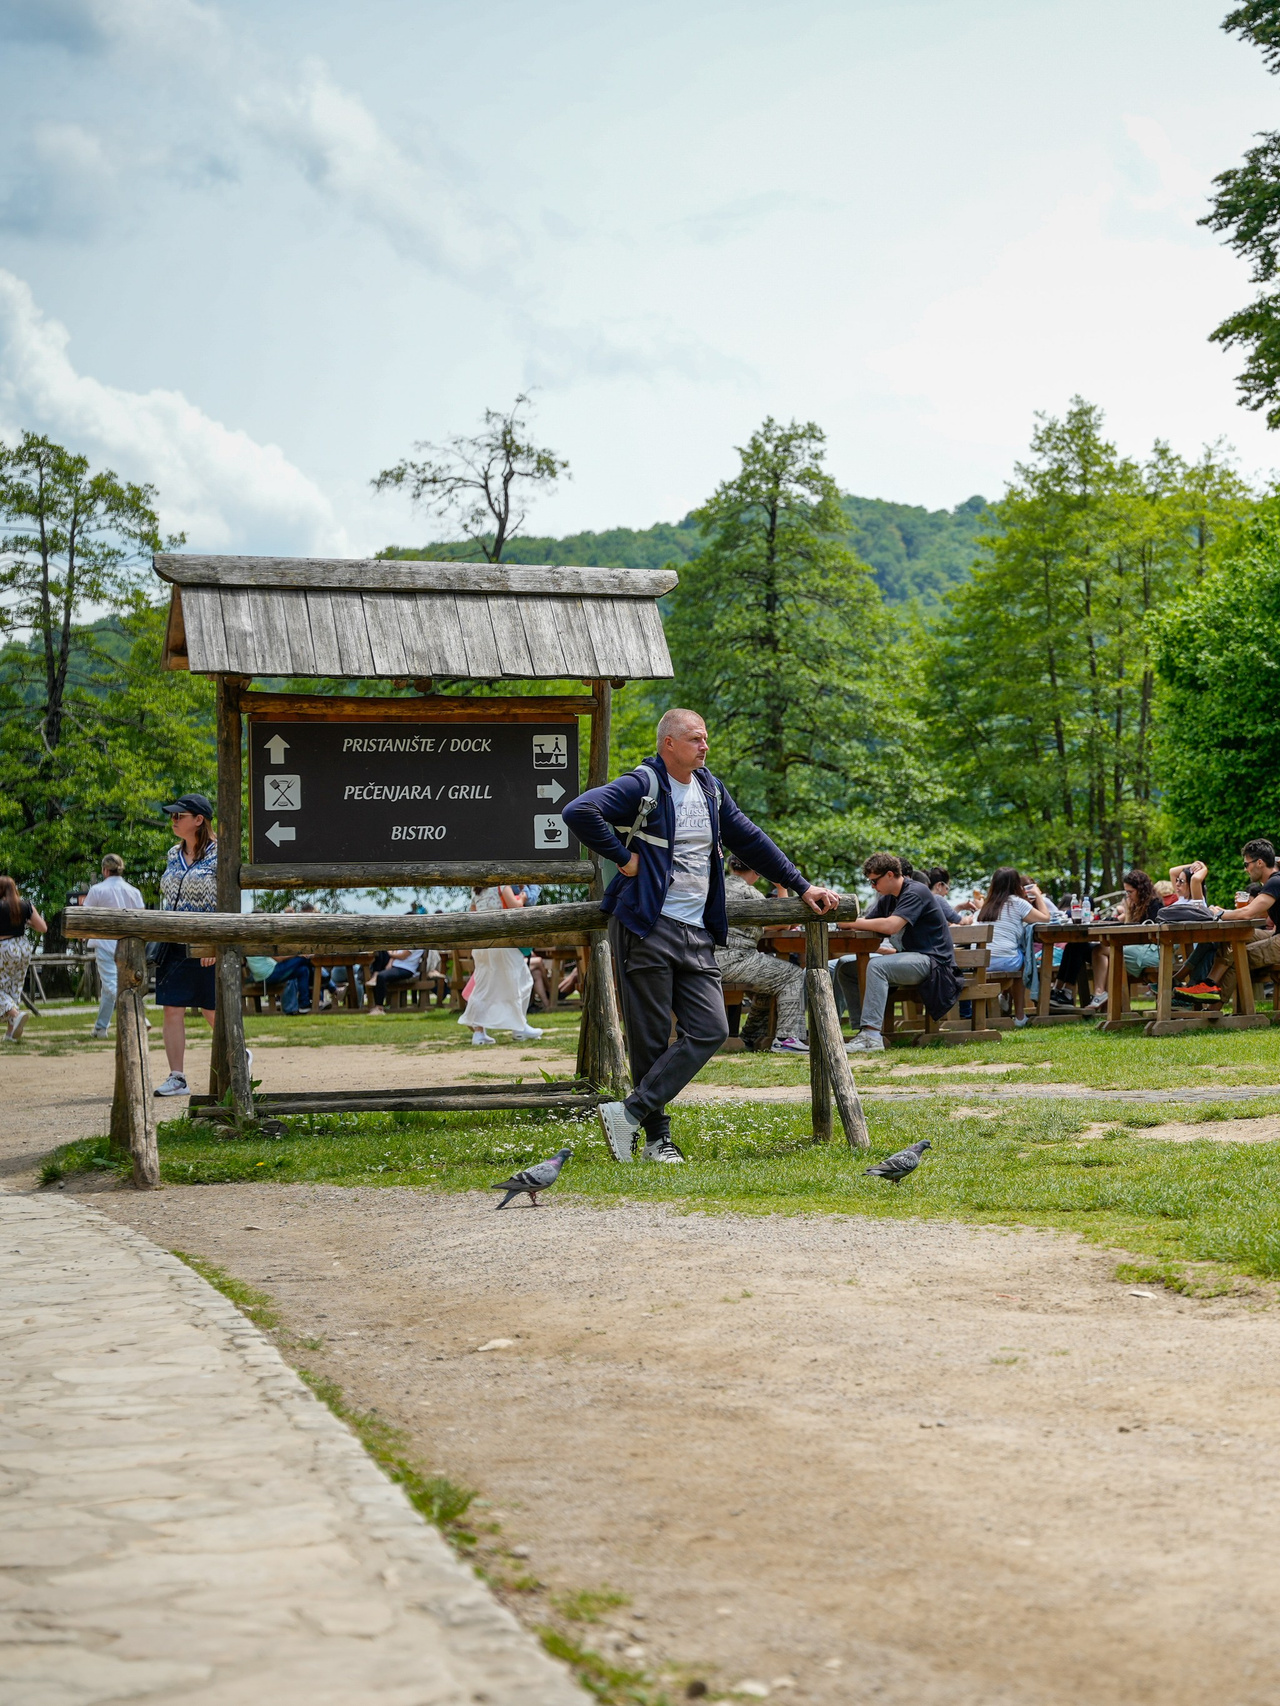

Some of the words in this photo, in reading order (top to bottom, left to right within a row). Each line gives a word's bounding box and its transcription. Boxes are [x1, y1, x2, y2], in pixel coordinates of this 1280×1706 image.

[342, 735, 435, 752] PRISTANIŠTE
[437, 738, 448, 752] /
[449, 738, 492, 752] DOCK
[343, 782, 432, 802] PEČENJARA
[435, 785, 446, 800] /
[447, 785, 493, 799] GRILL
[391, 825, 447, 840] BISTRO
